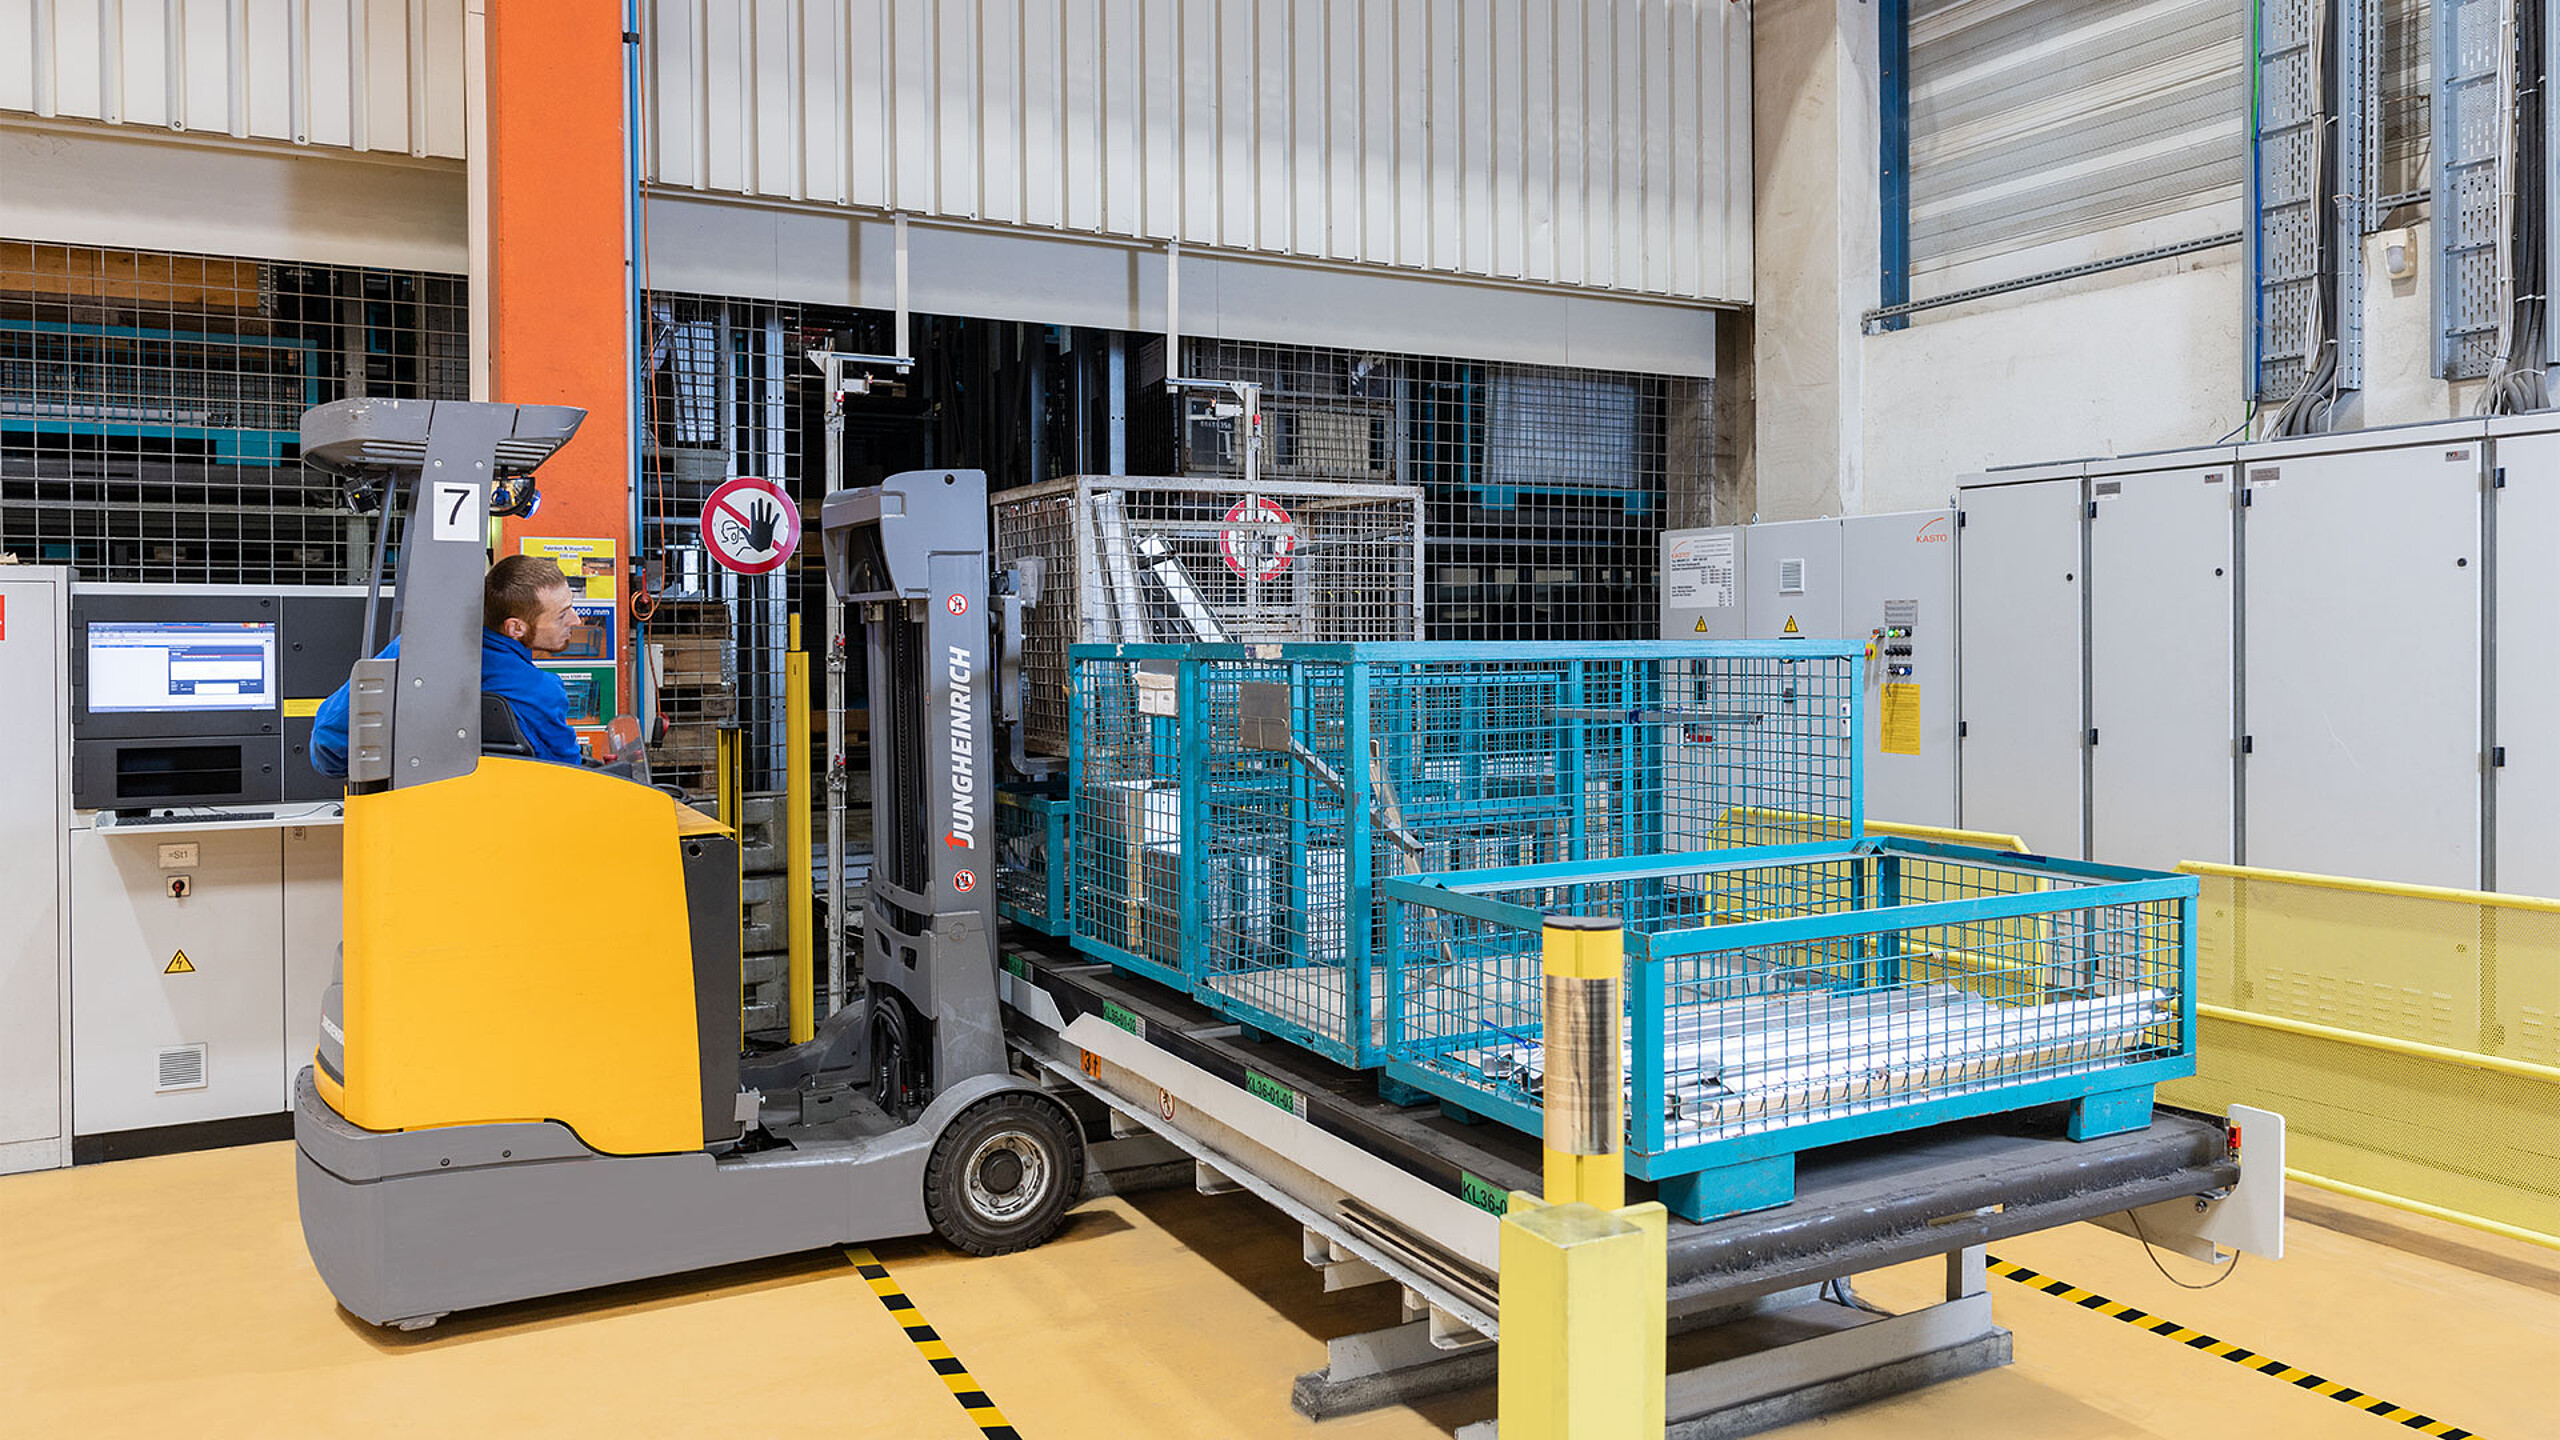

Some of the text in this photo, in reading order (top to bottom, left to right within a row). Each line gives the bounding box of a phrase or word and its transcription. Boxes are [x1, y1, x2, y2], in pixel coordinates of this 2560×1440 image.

[443, 488, 470, 525] 7
[1916, 534, 1948, 543] KASTO
[945, 646, 975, 851] JUNGHEINRICH
[1084, 1051, 1098, 1076] 3 t
[1247, 1076, 1293, 1111] KL36-01-03
